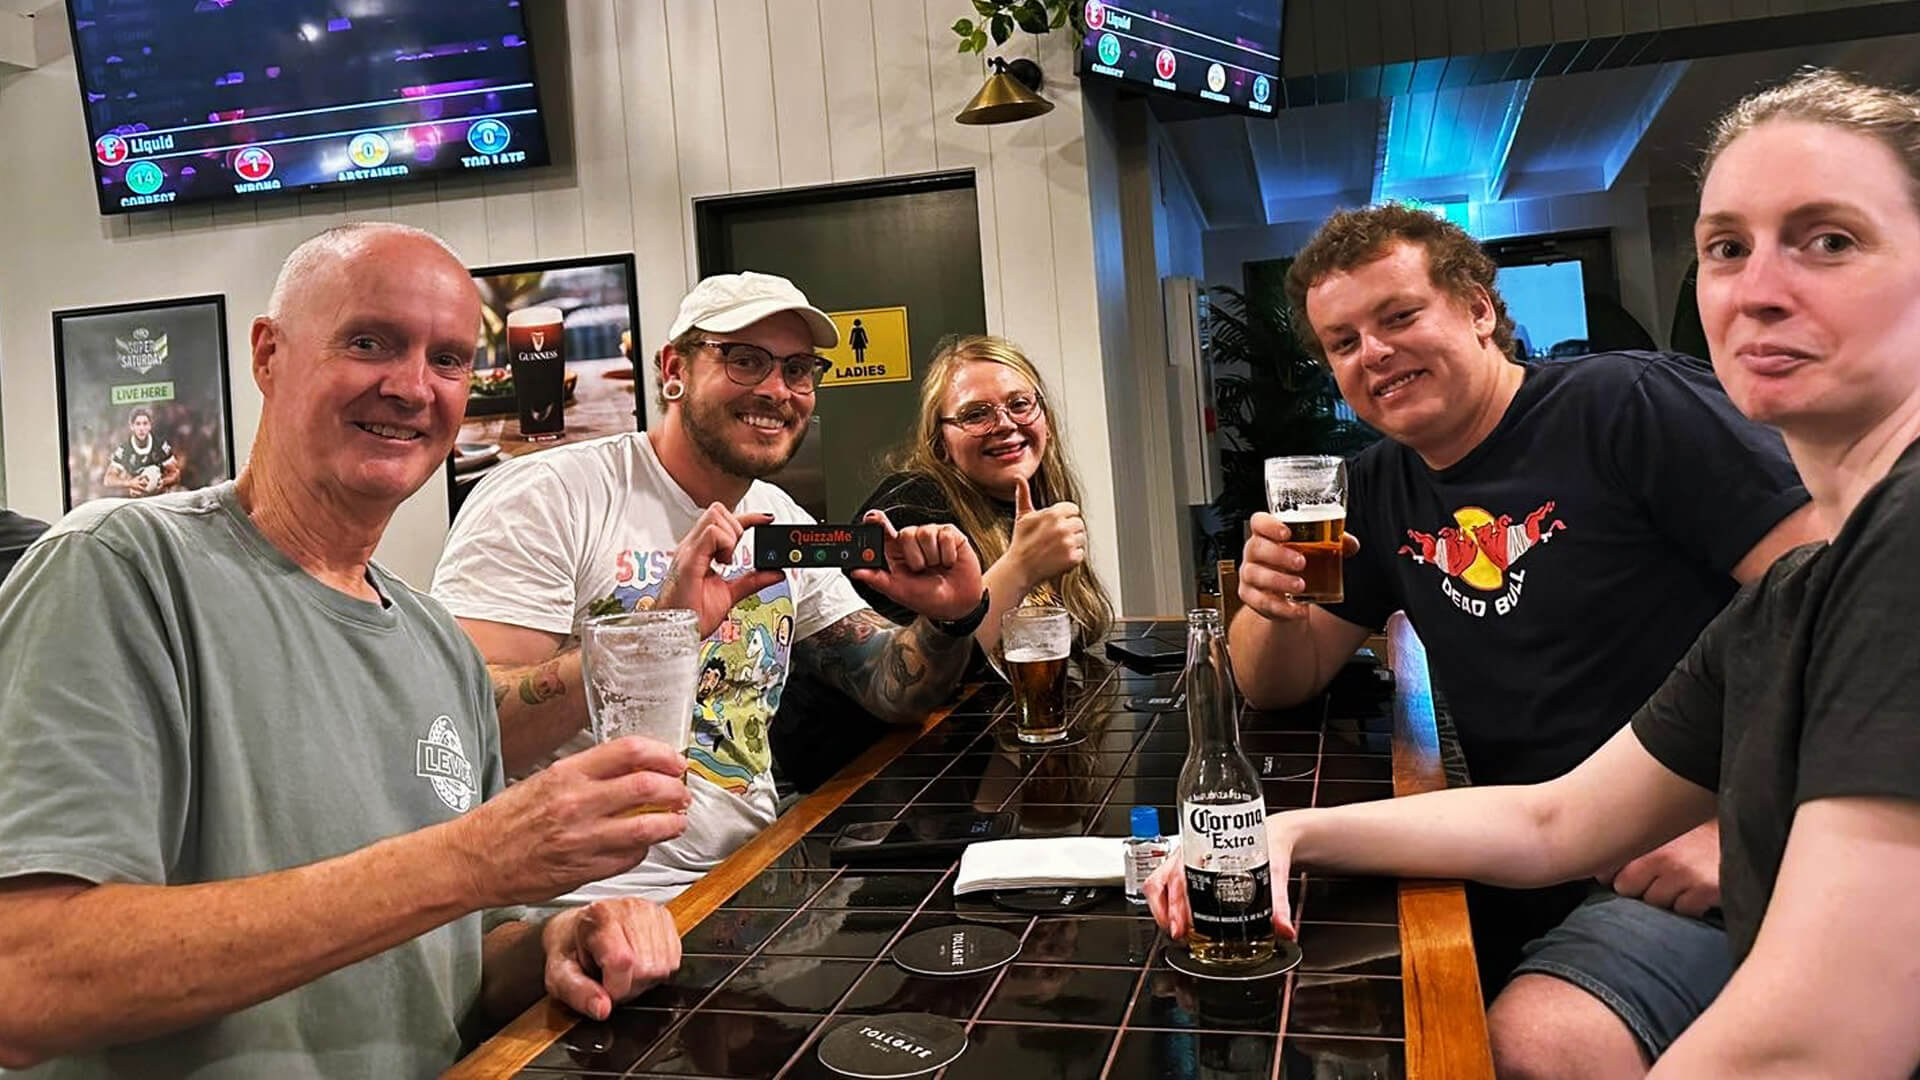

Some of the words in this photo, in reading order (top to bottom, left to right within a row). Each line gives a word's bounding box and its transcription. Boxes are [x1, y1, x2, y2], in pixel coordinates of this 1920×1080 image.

[134, 172, 154, 185] 14
[120, 352, 163, 369] SATURDAY
[836, 364, 886, 378] LADIES
[116, 388, 140, 400] LIVE
[141, 385, 168, 398] HERE
[1441, 577, 1486, 617] DEAD
[1494, 569, 1525, 615] BULL
[1190, 808, 1263, 838] Corona
[1212, 832, 1255, 849] Extra
[951, 932, 965, 966] TOLLGATE
[859, 1026, 933, 1059] TOLLGATE
